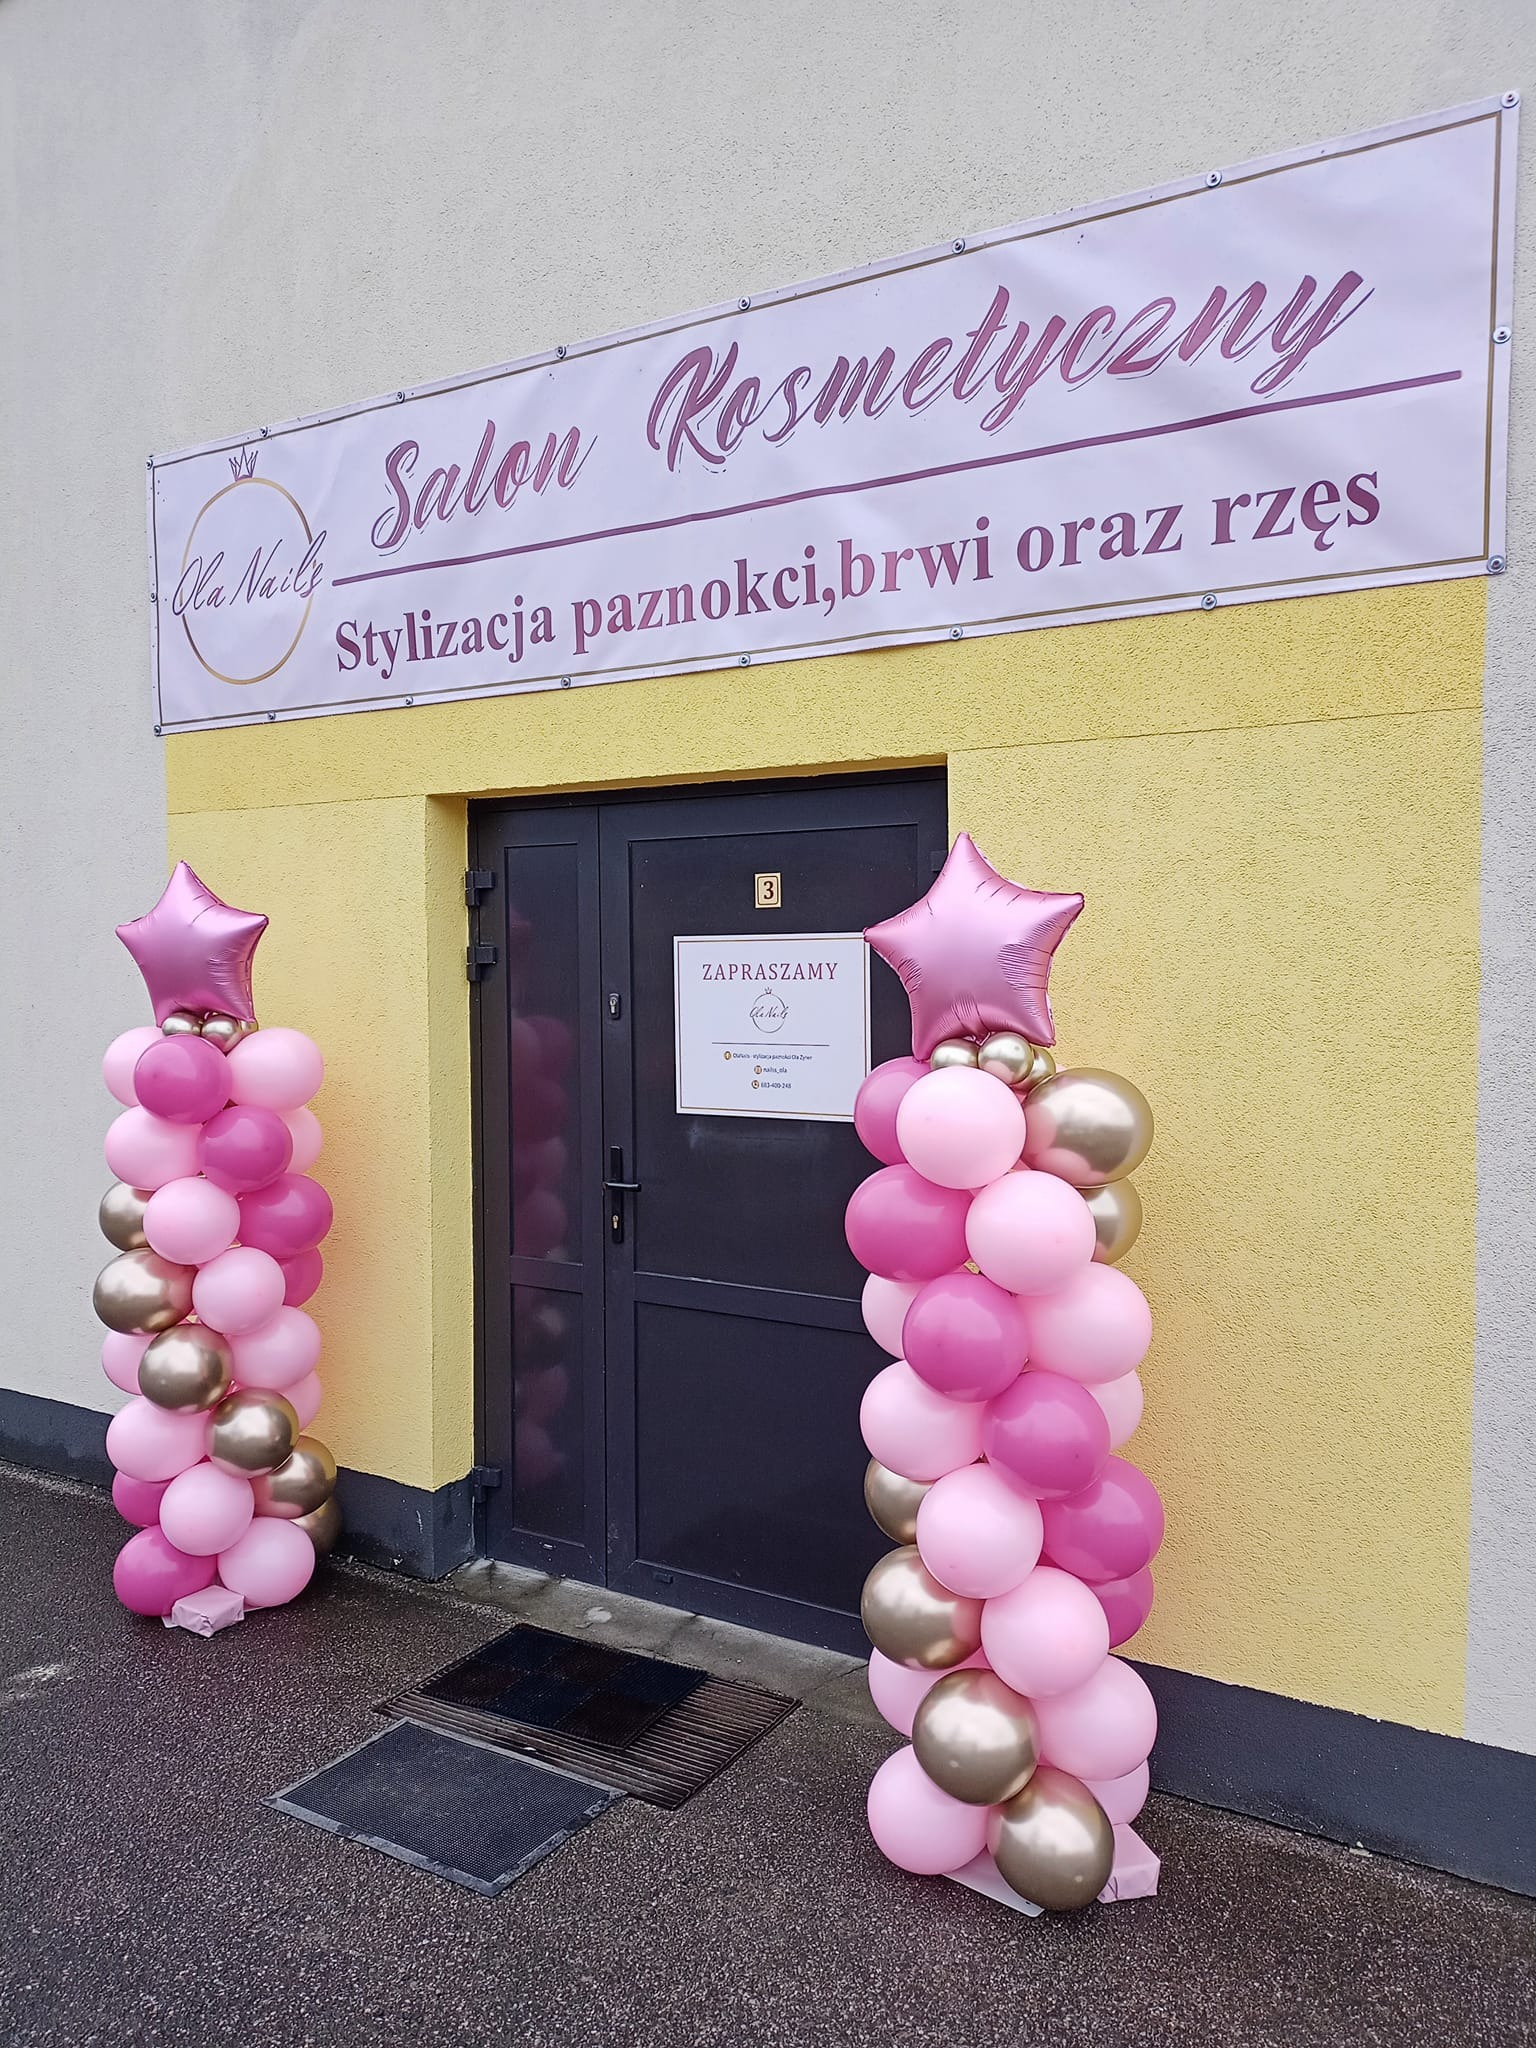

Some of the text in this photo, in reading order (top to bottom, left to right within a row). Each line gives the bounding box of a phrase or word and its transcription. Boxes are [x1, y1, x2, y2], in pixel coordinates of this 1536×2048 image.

[371, 270, 1375, 556] Salon Kosmetyczny
[172, 552, 226, 616] Ola
[336, 594, 556, 680] Stylizacja
[1016, 503, 1184, 573] oraz
[1211, 470, 1380, 552] rzęs
[763, 880, 774, 900] 3
[702, 962, 839, 981] ZAPRASZAMY
